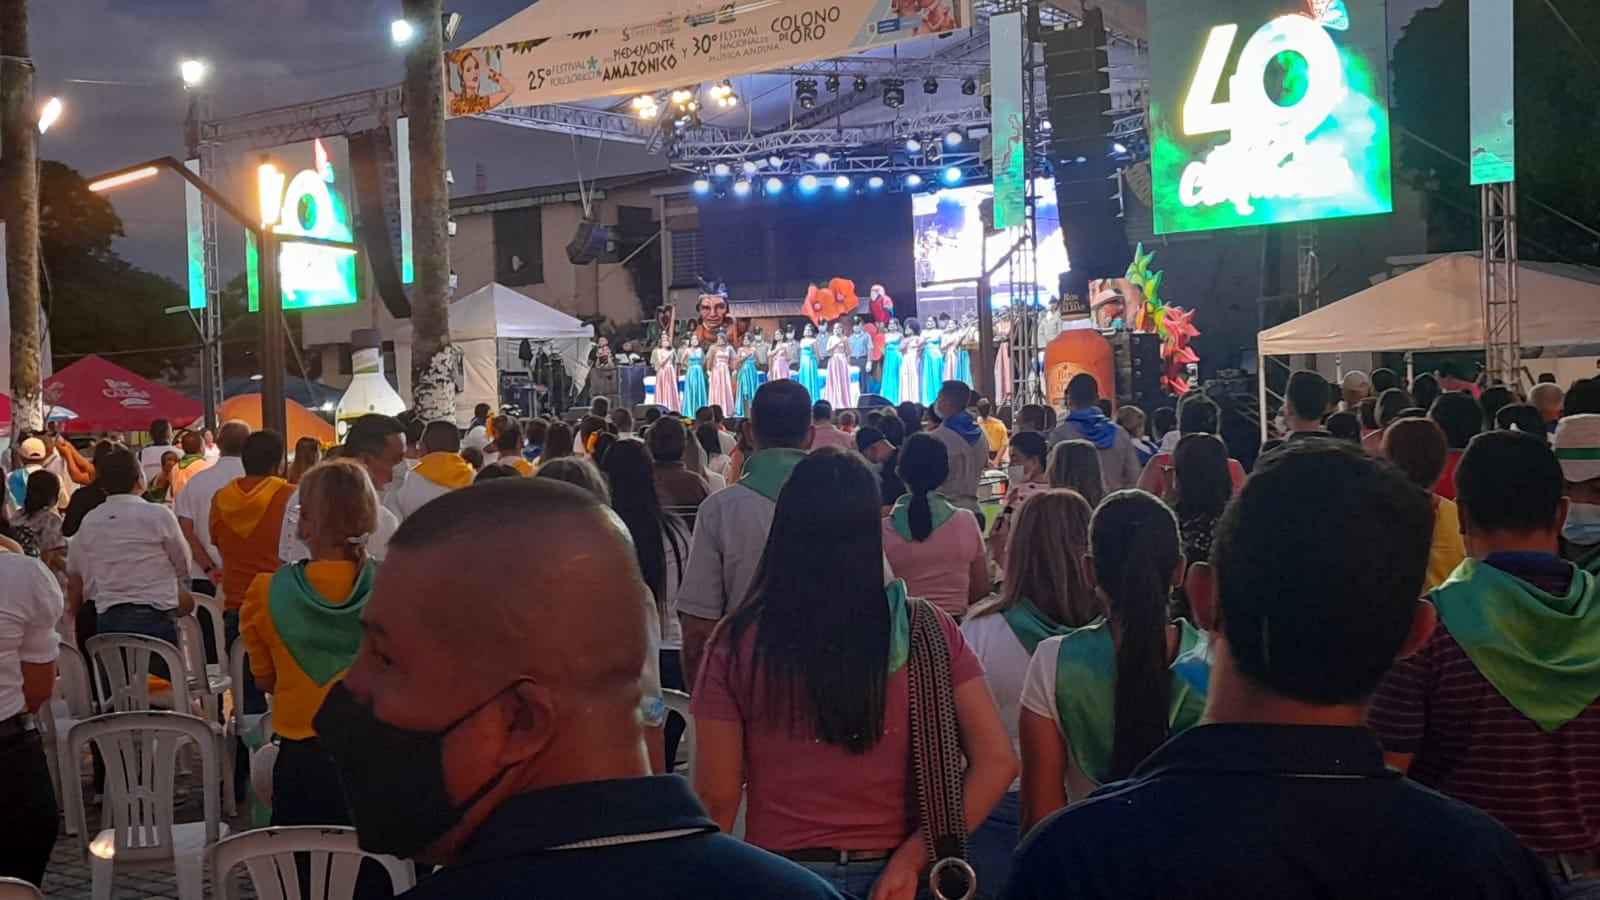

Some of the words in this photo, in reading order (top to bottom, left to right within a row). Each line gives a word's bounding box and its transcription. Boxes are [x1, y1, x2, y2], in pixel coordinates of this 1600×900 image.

[770, 5, 841, 33] COLONO
[719, 25, 758, 41] FESTIVAL
[778, 32, 789, 42] DE
[790, 24, 826, 45] ORO
[613, 38, 675, 61] PIEDEMONTE
[681, 48, 689, 60] Y
[742, 43, 780, 57] ANDINA
[552, 60, 586, 75] FESTIVAL
[602, 54, 677, 82] AMAZÓNICO
